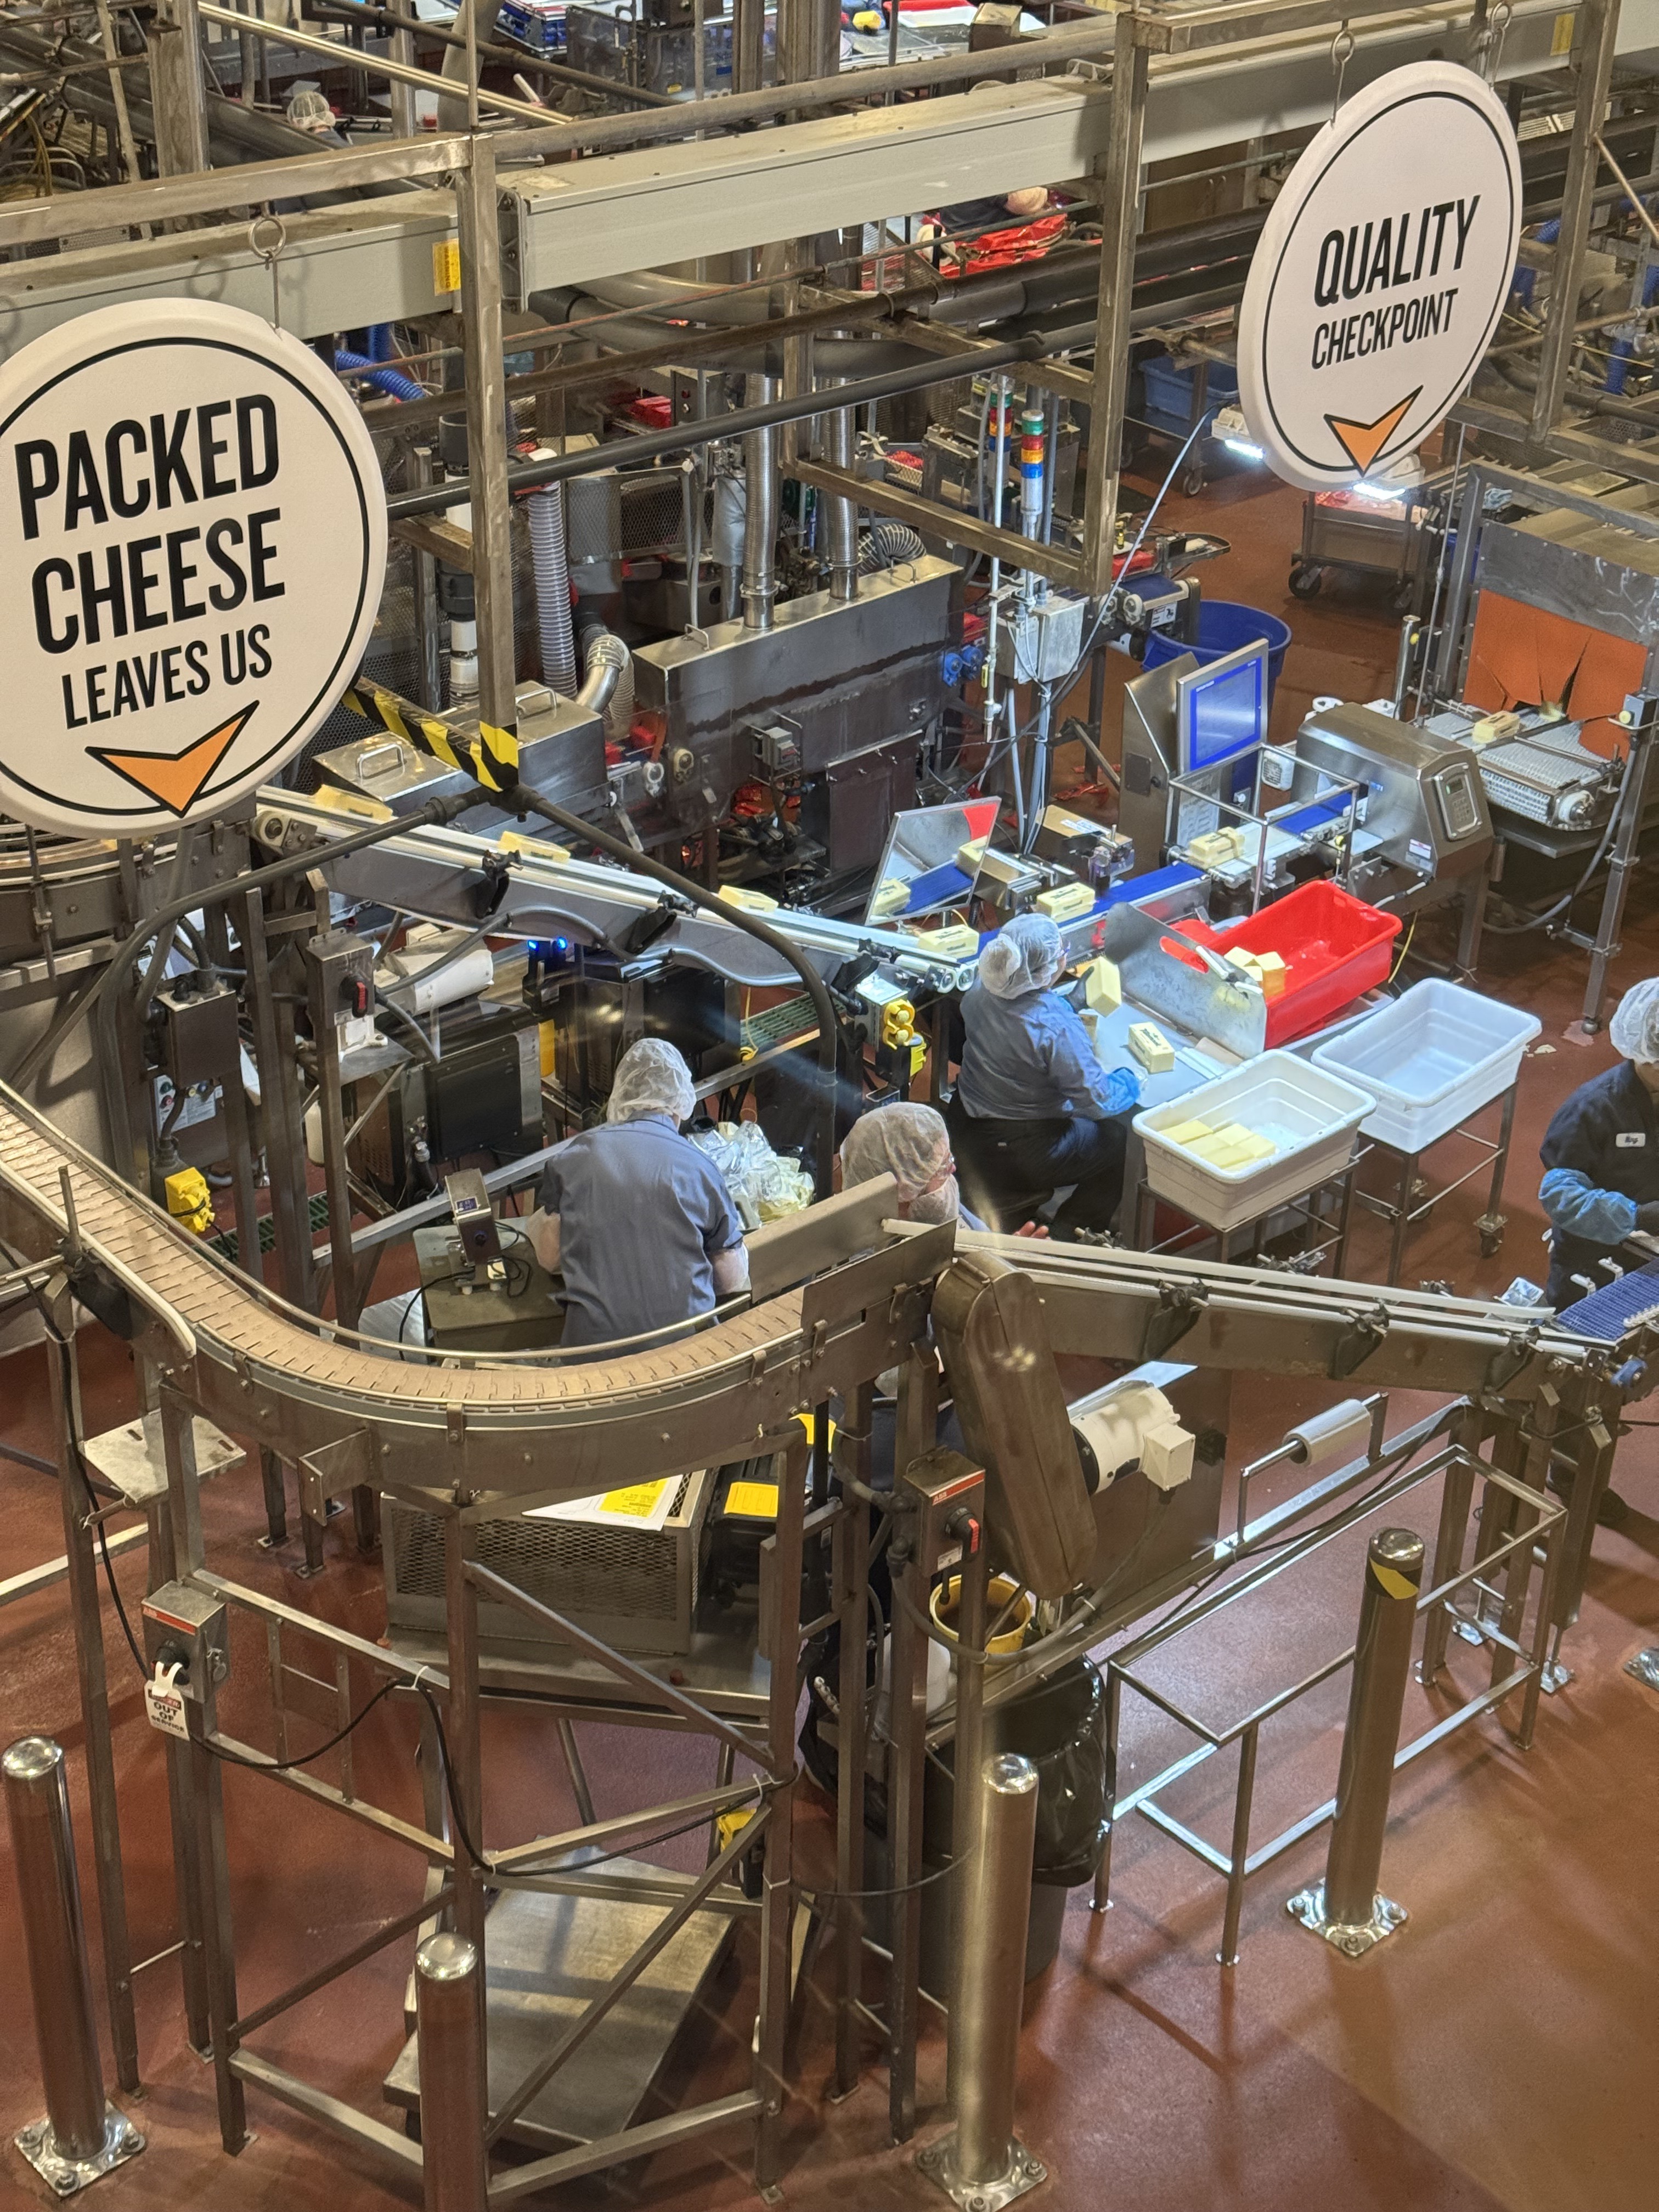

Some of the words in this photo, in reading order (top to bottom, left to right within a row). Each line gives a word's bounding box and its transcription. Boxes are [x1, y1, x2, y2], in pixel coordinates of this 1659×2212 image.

[1314, 195, 1481, 308] QUALITY
[1312, 289, 1458, 370] CHECKPOINT
[14, 394, 280, 541] PACKED
[31, 507, 285, 654] CHEESE
[61, 640, 210, 730] LEAVES
[221, 624, 272, 685] US
[154, 1701, 177, 1717] OUT
[159, 1711, 174, 1721] OF
